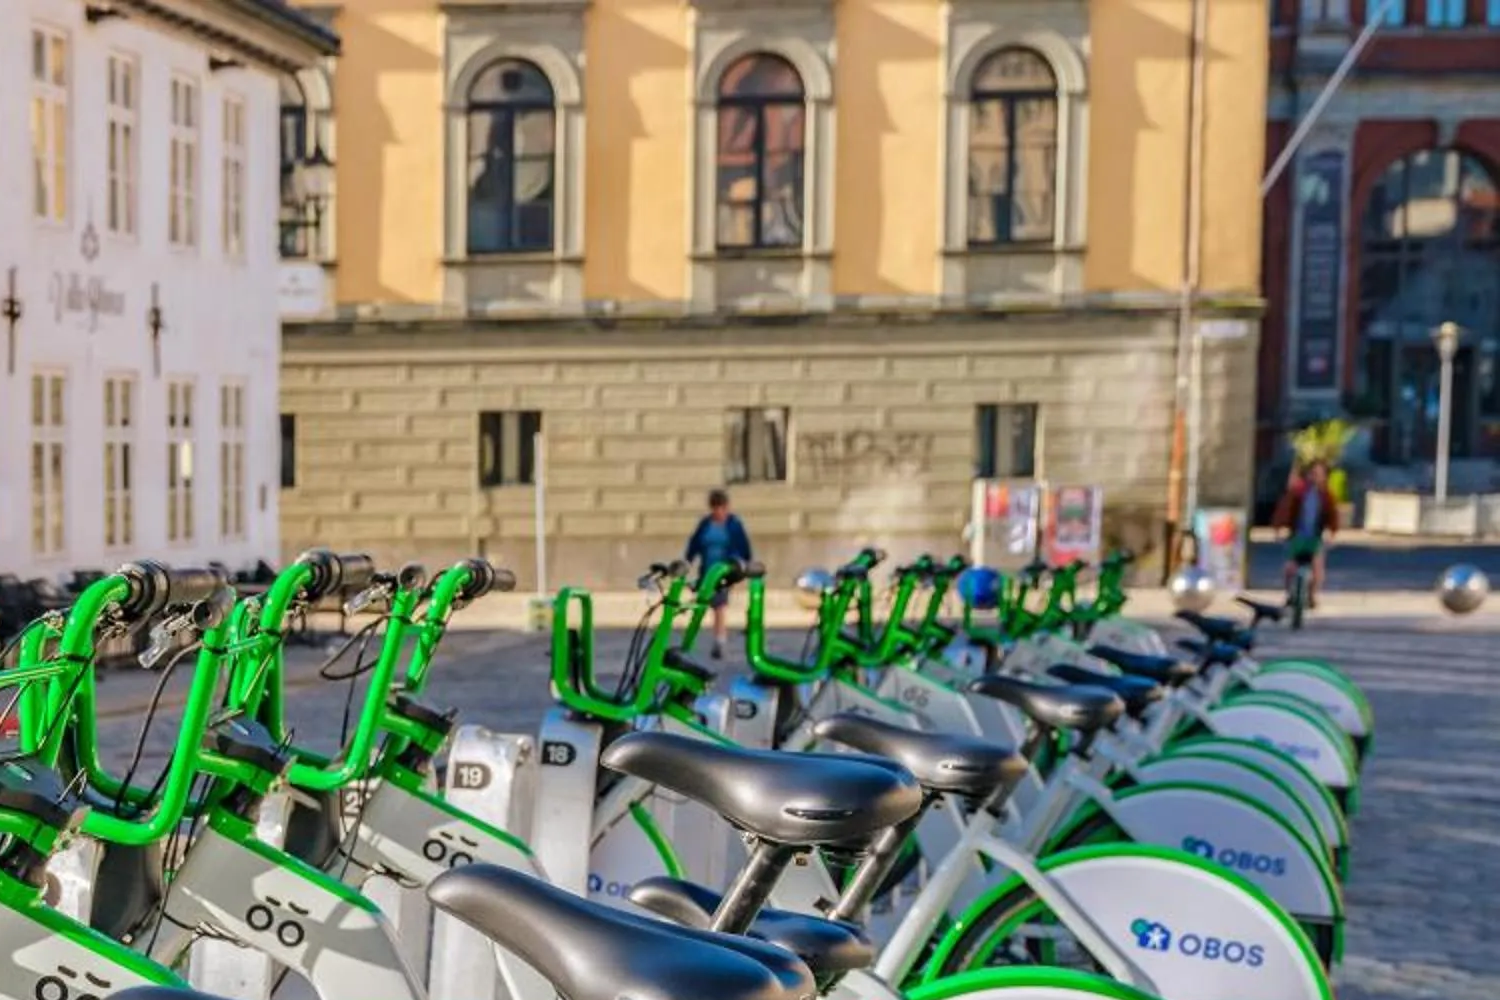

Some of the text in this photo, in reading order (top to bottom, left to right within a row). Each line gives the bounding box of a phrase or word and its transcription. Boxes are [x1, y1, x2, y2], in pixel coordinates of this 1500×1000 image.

[548, 744, 570, 764] 18
[457, 766, 484, 787] 19
[1218, 848, 1286, 877] OBOS
[1179, 933, 1265, 967] OBOS
